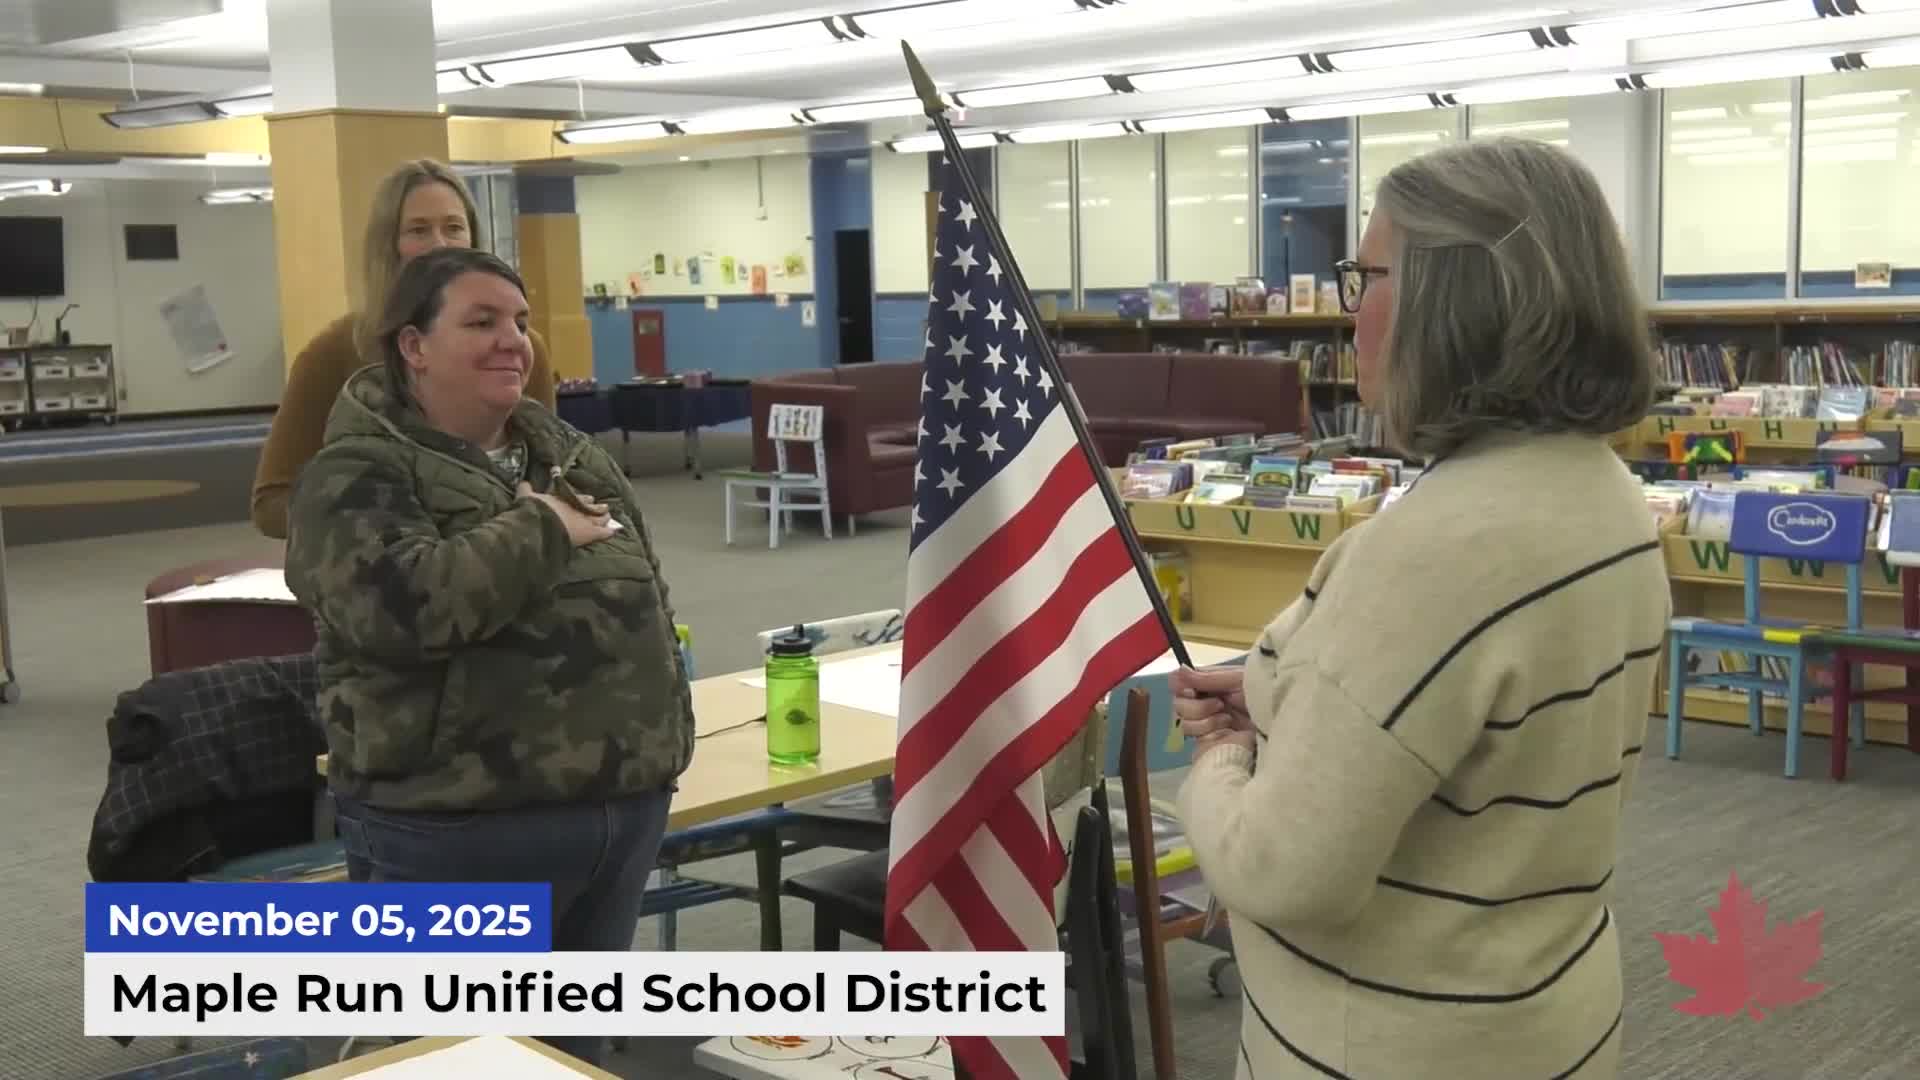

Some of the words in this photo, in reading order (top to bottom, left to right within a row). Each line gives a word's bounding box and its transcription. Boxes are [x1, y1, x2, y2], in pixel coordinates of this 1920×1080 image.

[1763, 420, 1783, 440] H
[1176, 505, 1195, 530] U
[1232, 510, 1250, 536] V
[1290, 512, 1321, 540] W
[1690, 540, 1730, 572] W
